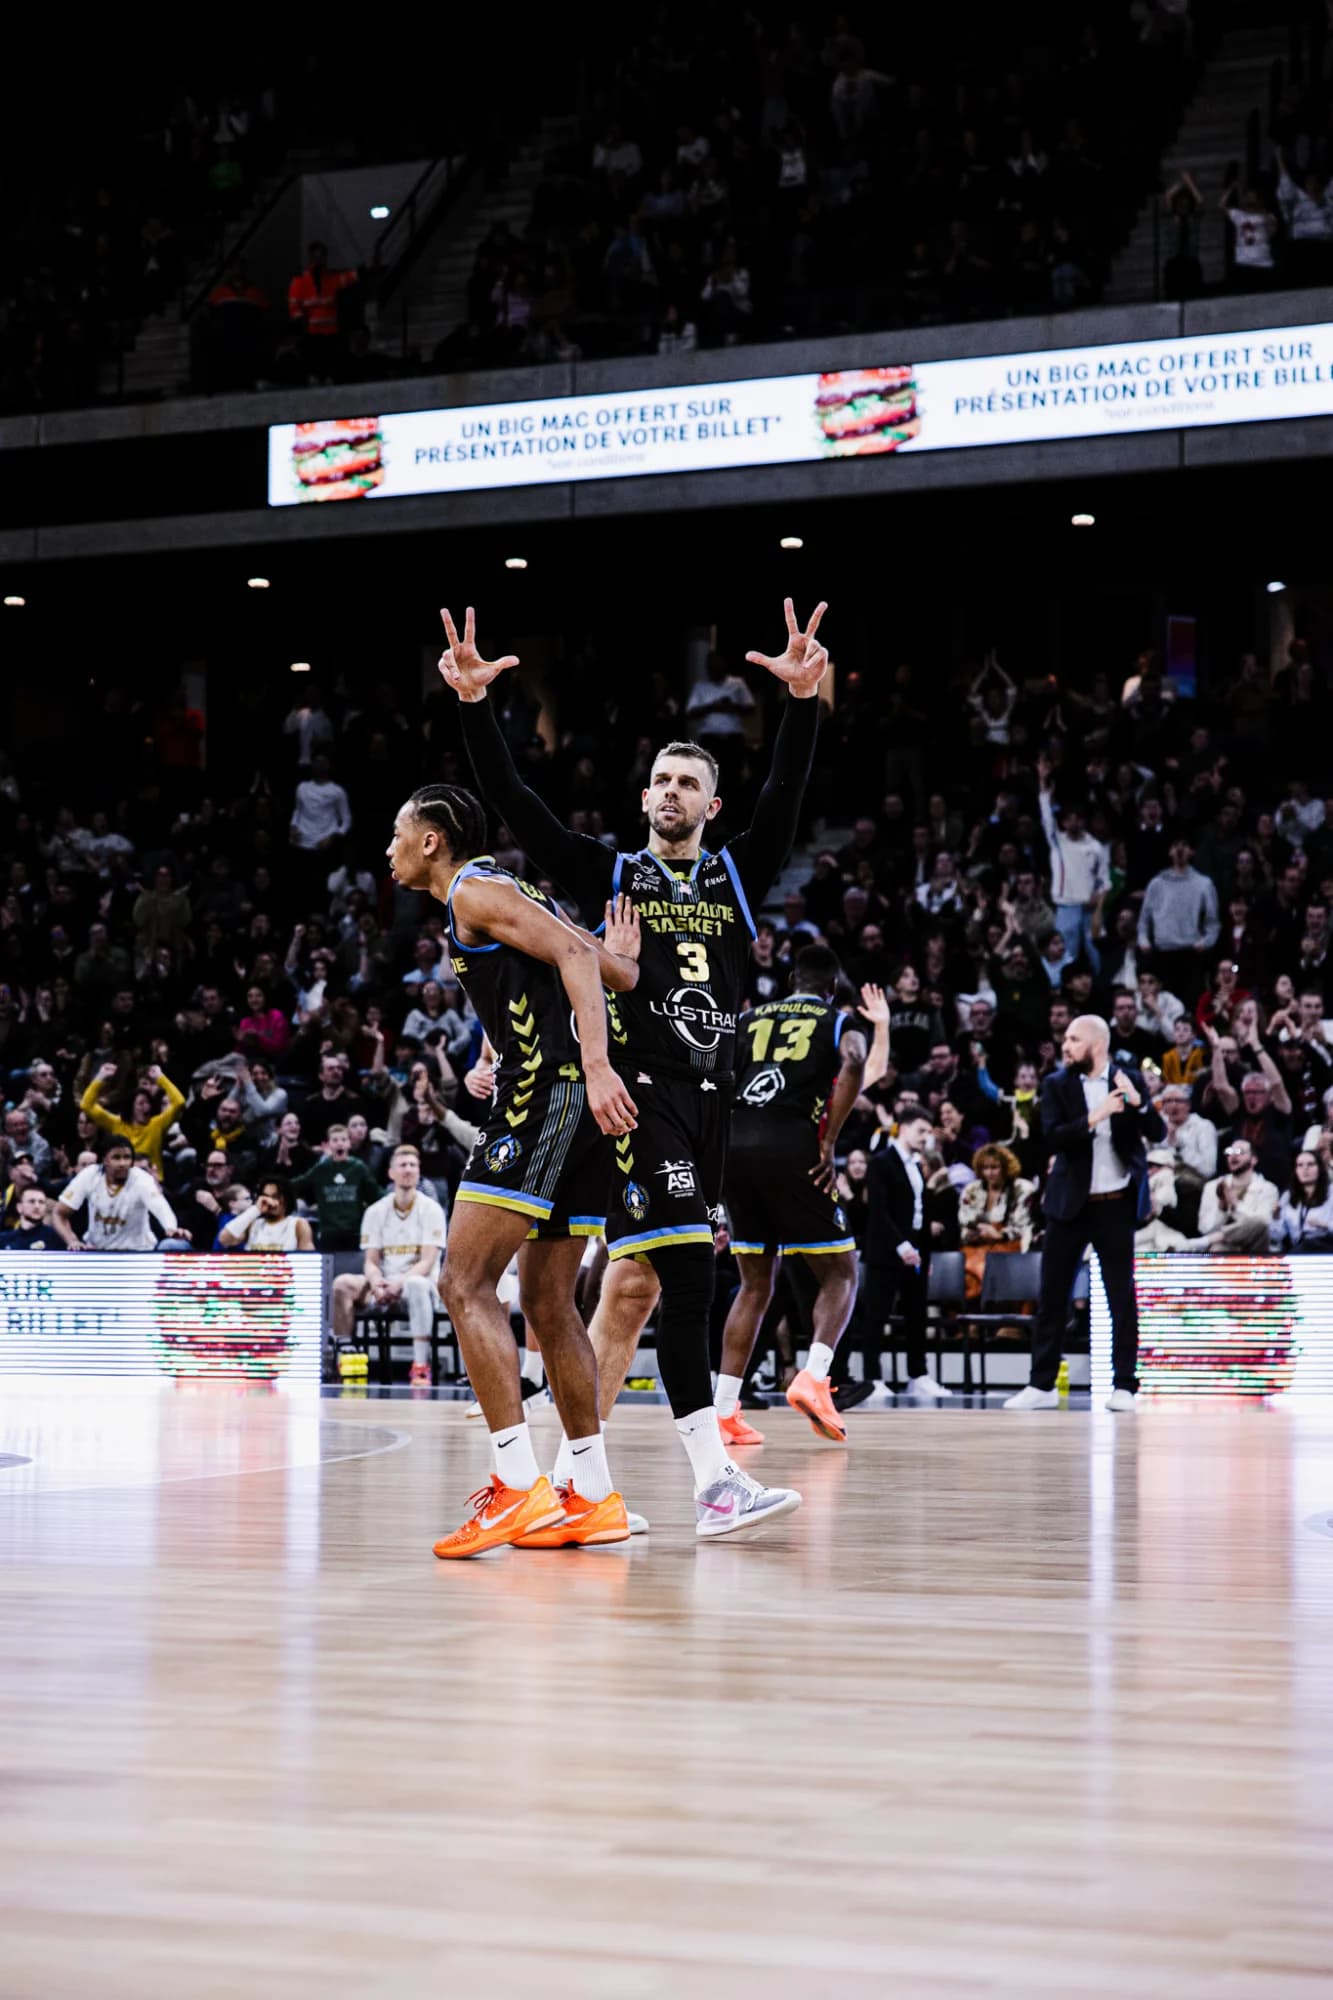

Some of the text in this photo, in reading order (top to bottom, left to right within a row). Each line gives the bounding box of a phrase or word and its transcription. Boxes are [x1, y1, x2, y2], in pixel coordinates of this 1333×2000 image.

[1007, 341, 1313, 387] UN BIG MAC OFFERT SUR
[954, 363, 1333, 416] PRÉSENTATION DE VOTRE BILL
[461, 398, 732, 439] UN BIG MAC OFFERT SUR
[414, 435, 577, 465] PRÉSENTATION
[584, 430, 613, 450] DE
[617, 423, 689, 447] VOTRE
[676, 942, 710, 982] 3
[747, 1018, 817, 1062] 13
[667, 1171, 695, 1191] ASI
